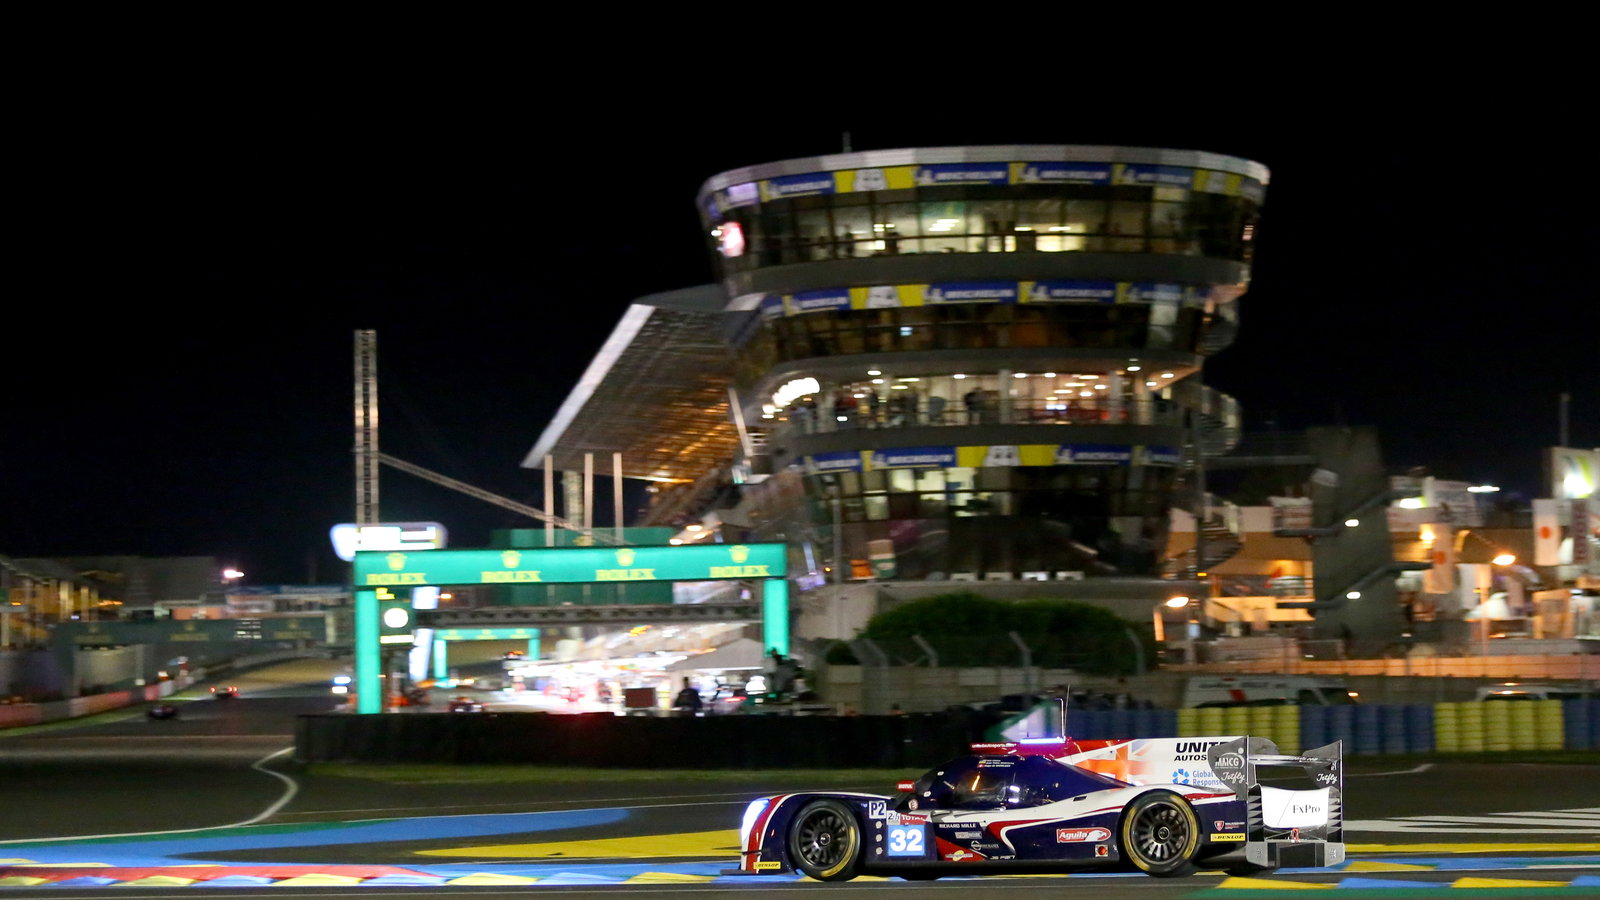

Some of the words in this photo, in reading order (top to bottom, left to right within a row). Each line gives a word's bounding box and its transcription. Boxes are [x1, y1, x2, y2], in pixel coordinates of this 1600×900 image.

[481, 570, 542, 583] ROLEX
[595, 568, 656, 581] ROLEX
[709, 565, 770, 578] ROLEX
[366, 573, 428, 586] ROLEX
[1192, 770, 1214, 778] Global
[1221, 771, 1246, 784] Jetfly
[1316, 773, 1338, 784] Jetfly
[871, 802, 885, 816] P2
[1293, 804, 1321, 814] FxPro
[901, 814, 927, 822] TOTAL
[890, 829, 923, 852] 32
